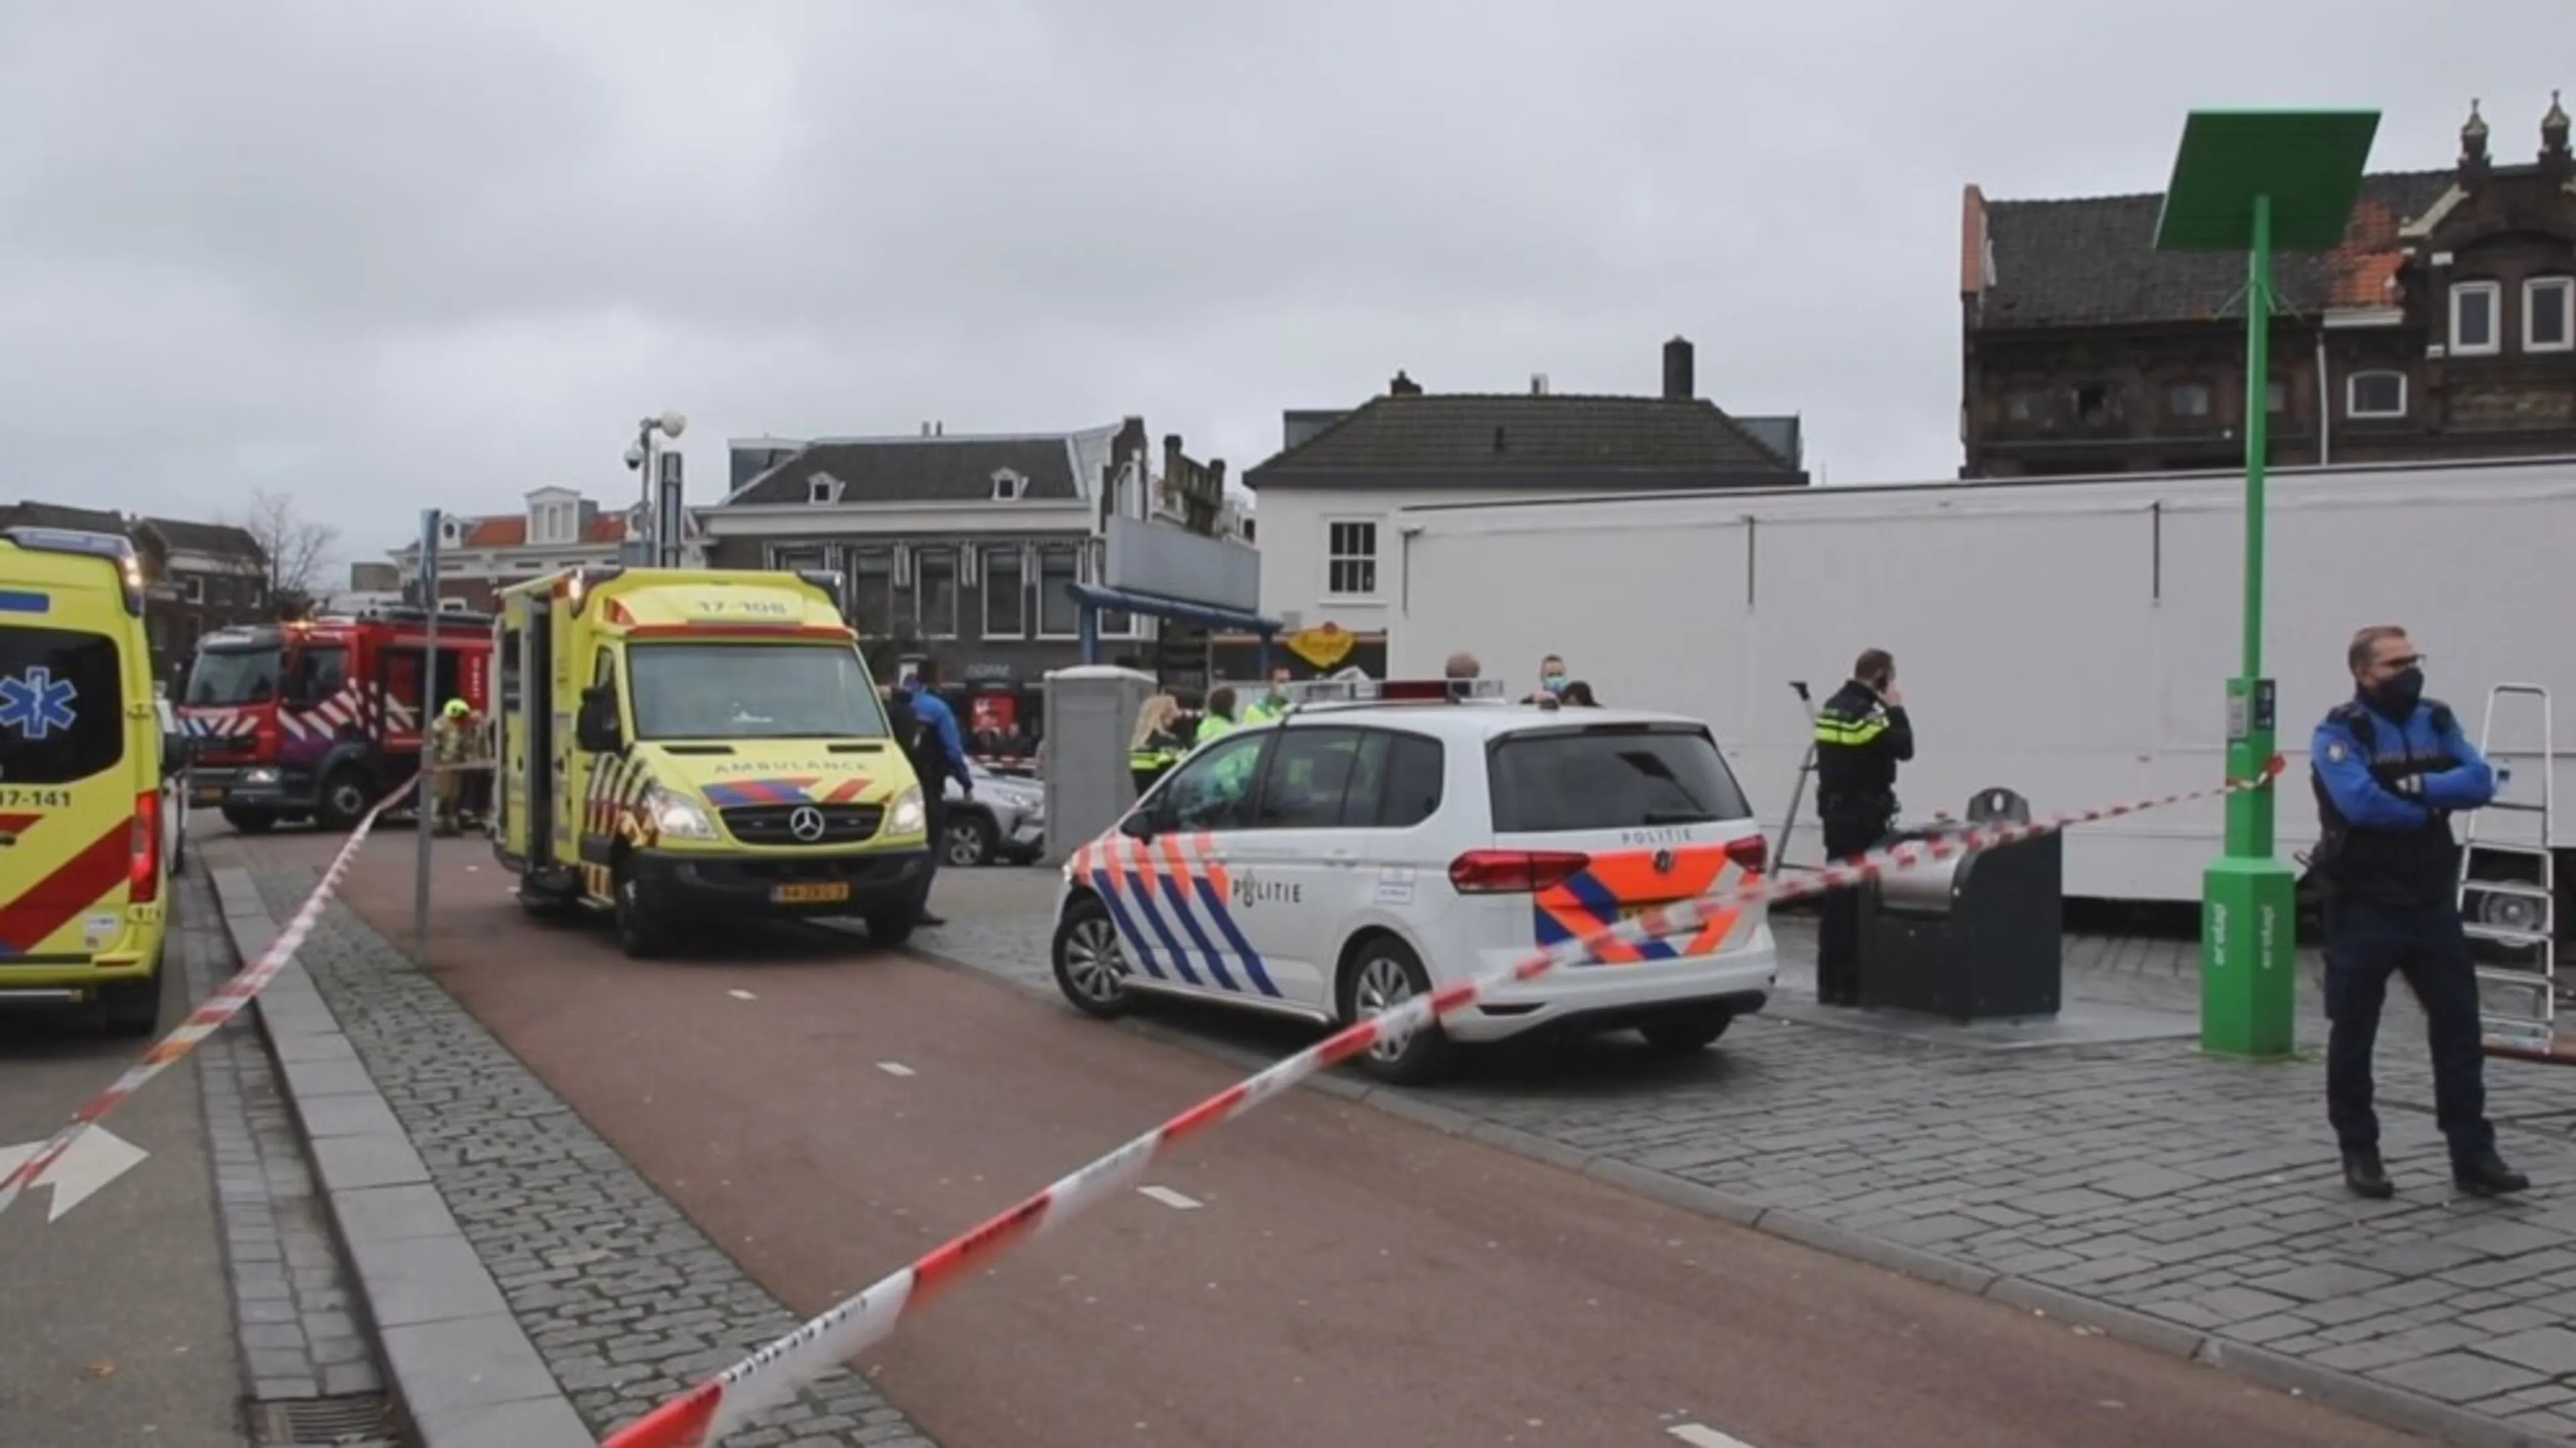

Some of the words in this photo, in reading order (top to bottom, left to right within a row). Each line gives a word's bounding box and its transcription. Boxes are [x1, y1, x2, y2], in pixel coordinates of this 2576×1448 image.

[714, 760, 867, 774] AMBULANCE
[1621, 826, 1693, 845] POLITIE
[1232, 876, 1302, 907] POLITIE
